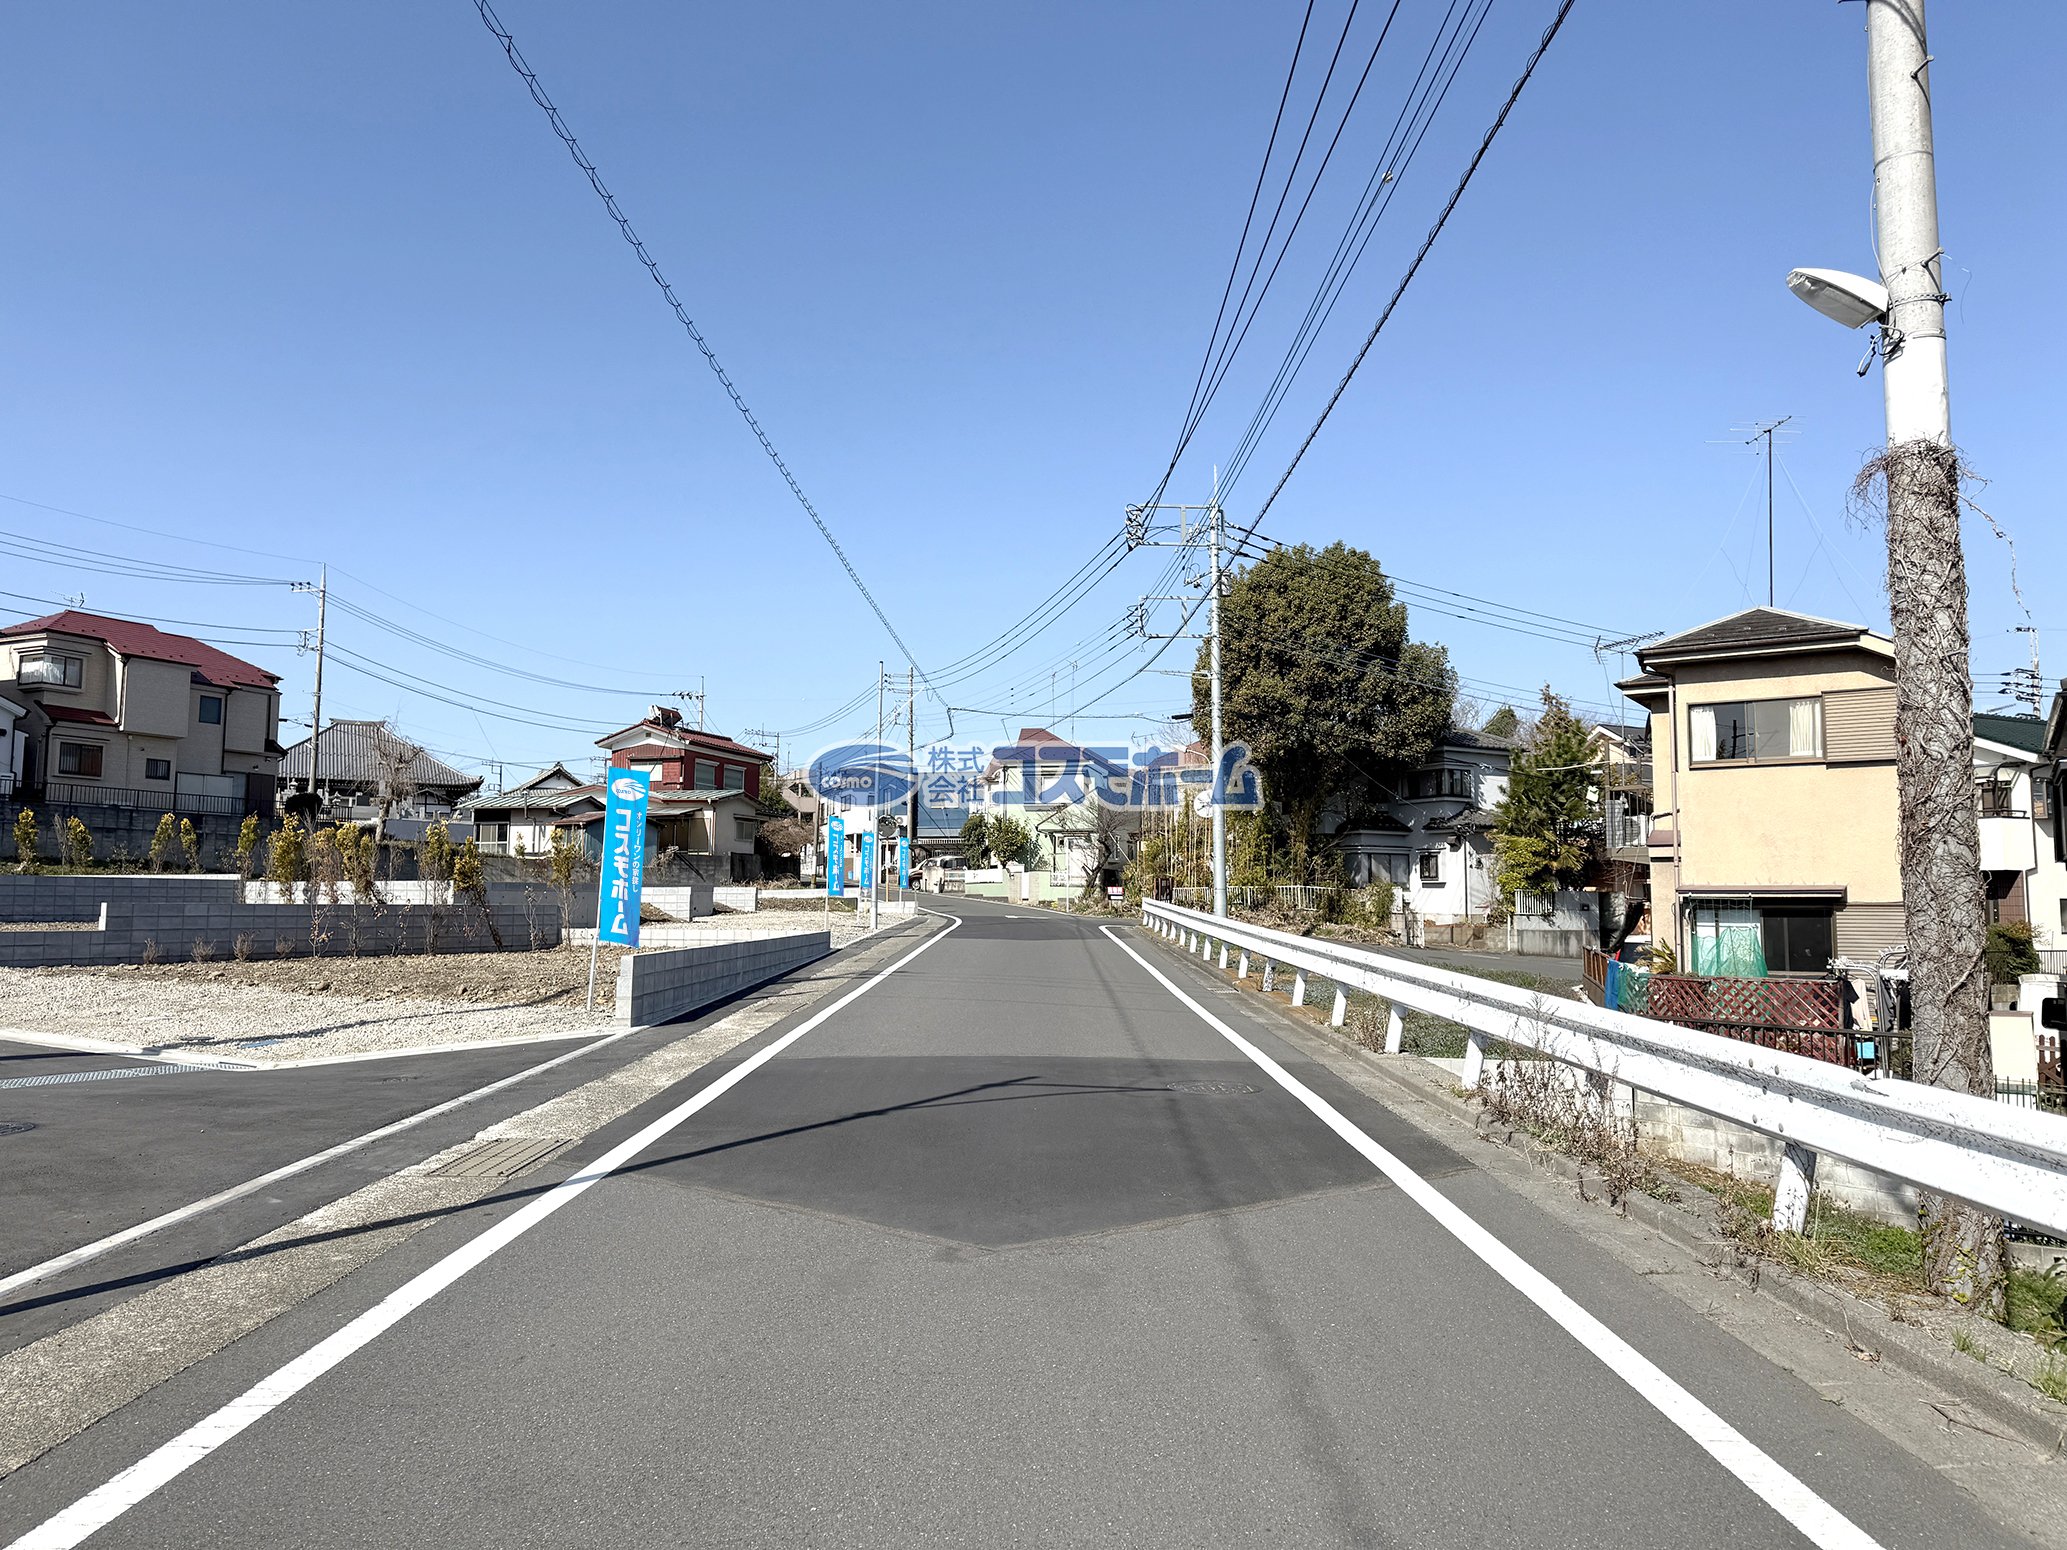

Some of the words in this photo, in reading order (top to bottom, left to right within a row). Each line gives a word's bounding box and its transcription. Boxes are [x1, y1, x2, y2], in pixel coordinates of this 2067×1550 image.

[610, 809, 632, 935] コスモホーム
